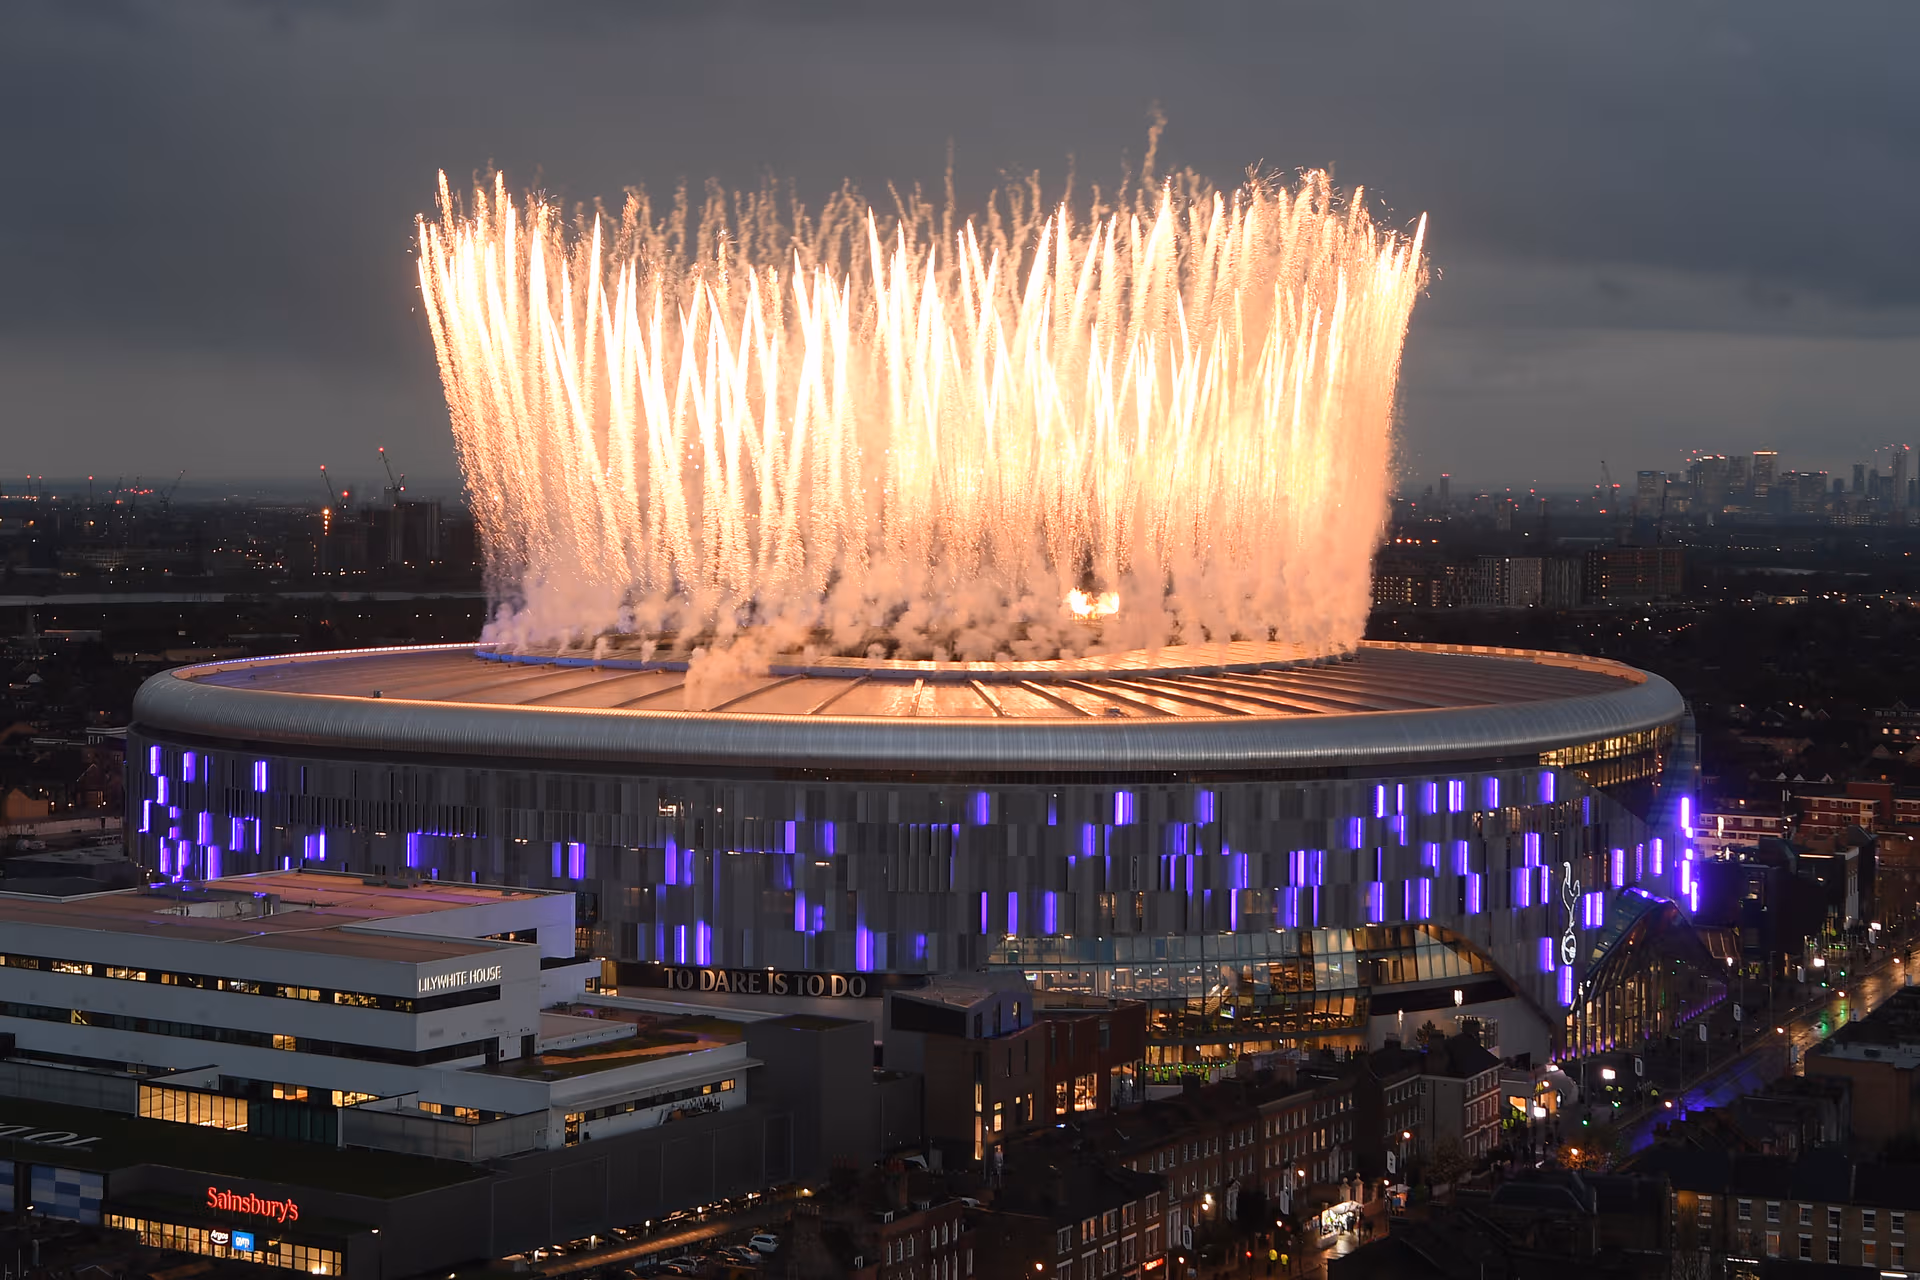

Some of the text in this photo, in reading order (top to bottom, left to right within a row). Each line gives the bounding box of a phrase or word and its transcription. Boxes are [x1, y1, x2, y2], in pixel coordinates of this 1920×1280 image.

[418, 965, 502, 992] LILYWHITE HOUSE
[664, 967, 866, 998] TO DARE IS TO DO
[206, 1187, 299, 1223] Sainsbury's
[210, 1229, 229, 1241] Argos
